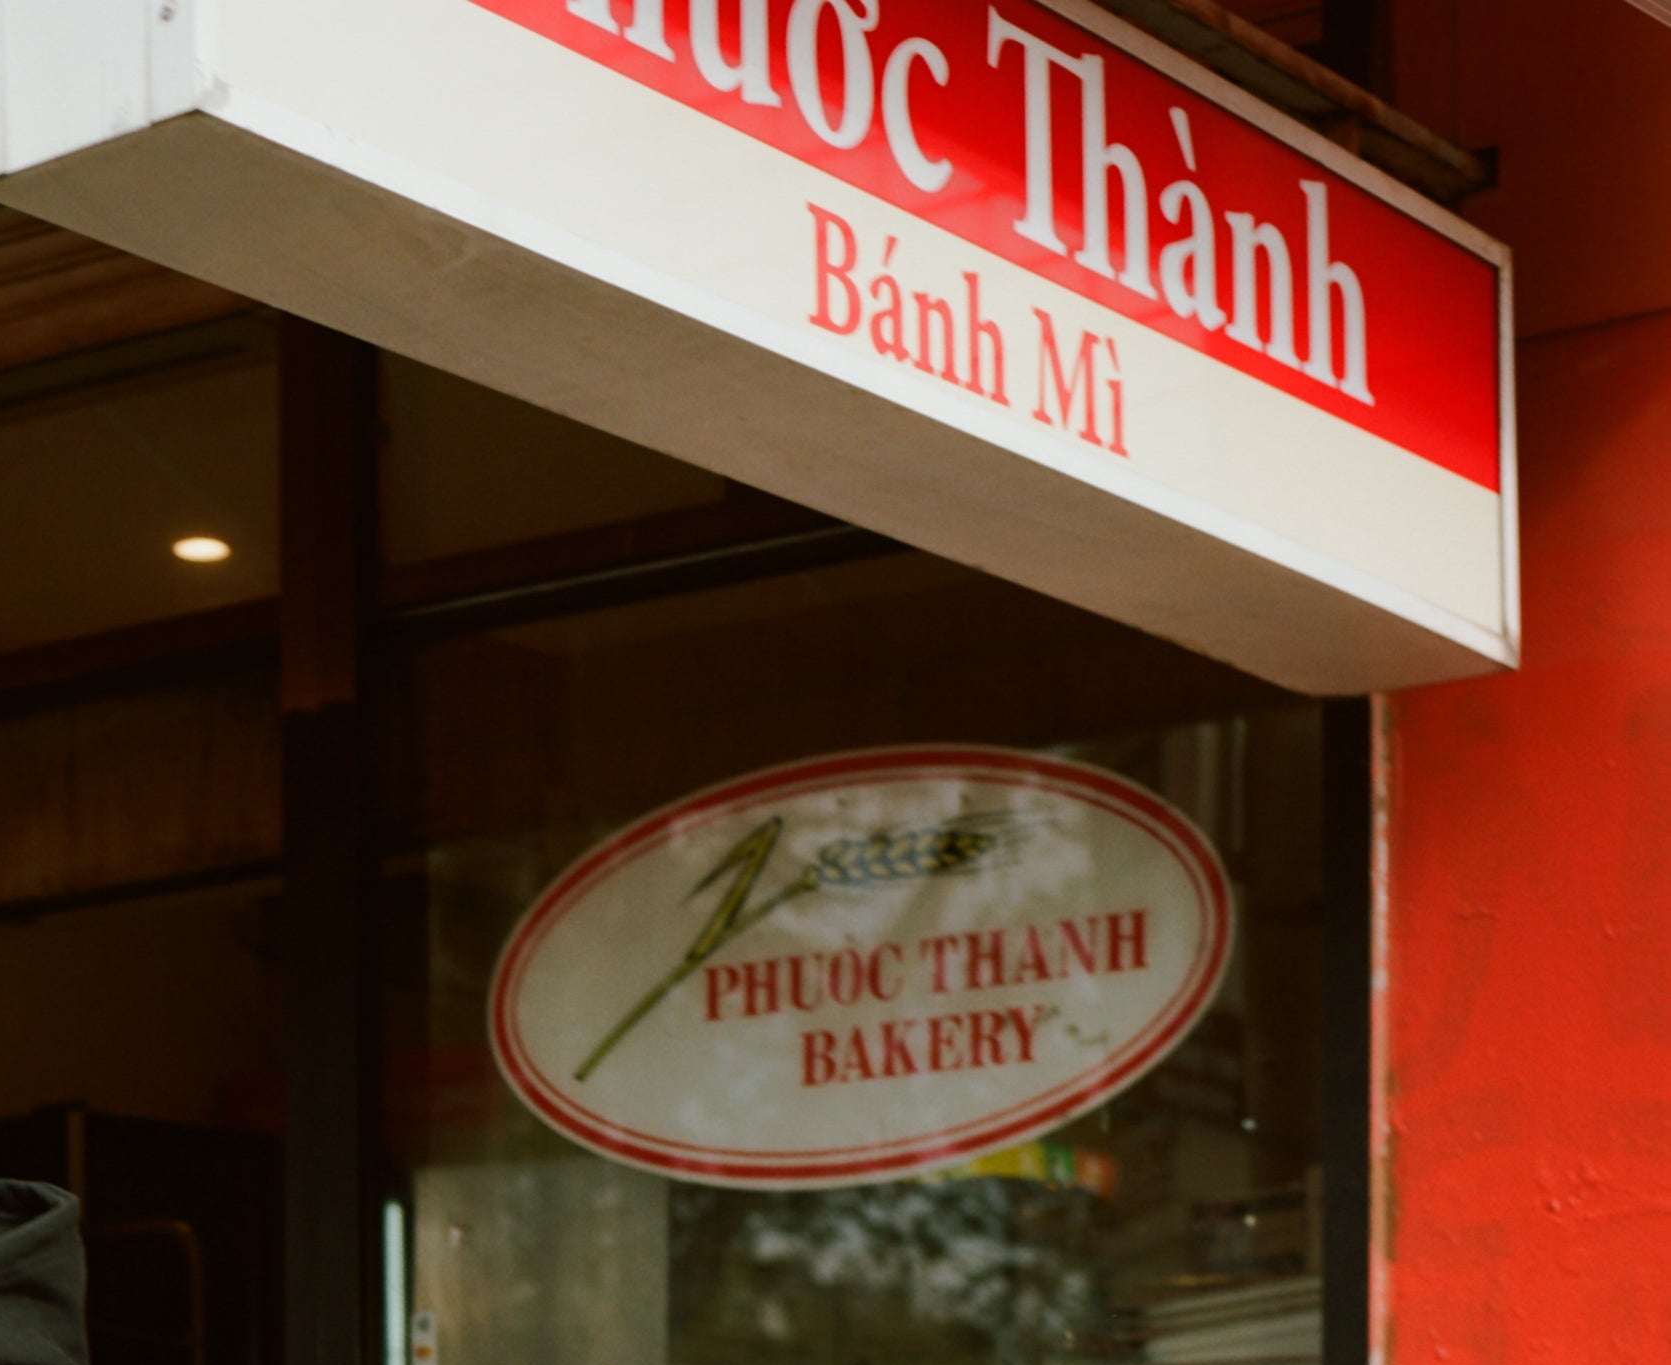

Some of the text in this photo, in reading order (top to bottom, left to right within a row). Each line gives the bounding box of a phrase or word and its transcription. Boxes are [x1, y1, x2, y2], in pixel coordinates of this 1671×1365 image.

[987, 4, 1376, 406] Thành
[805, 201, 1012, 407] Bánh
[704, 908, 1149, 1023] PHUOC THANH
[801, 1004, 1044, 1088] BAKERY
